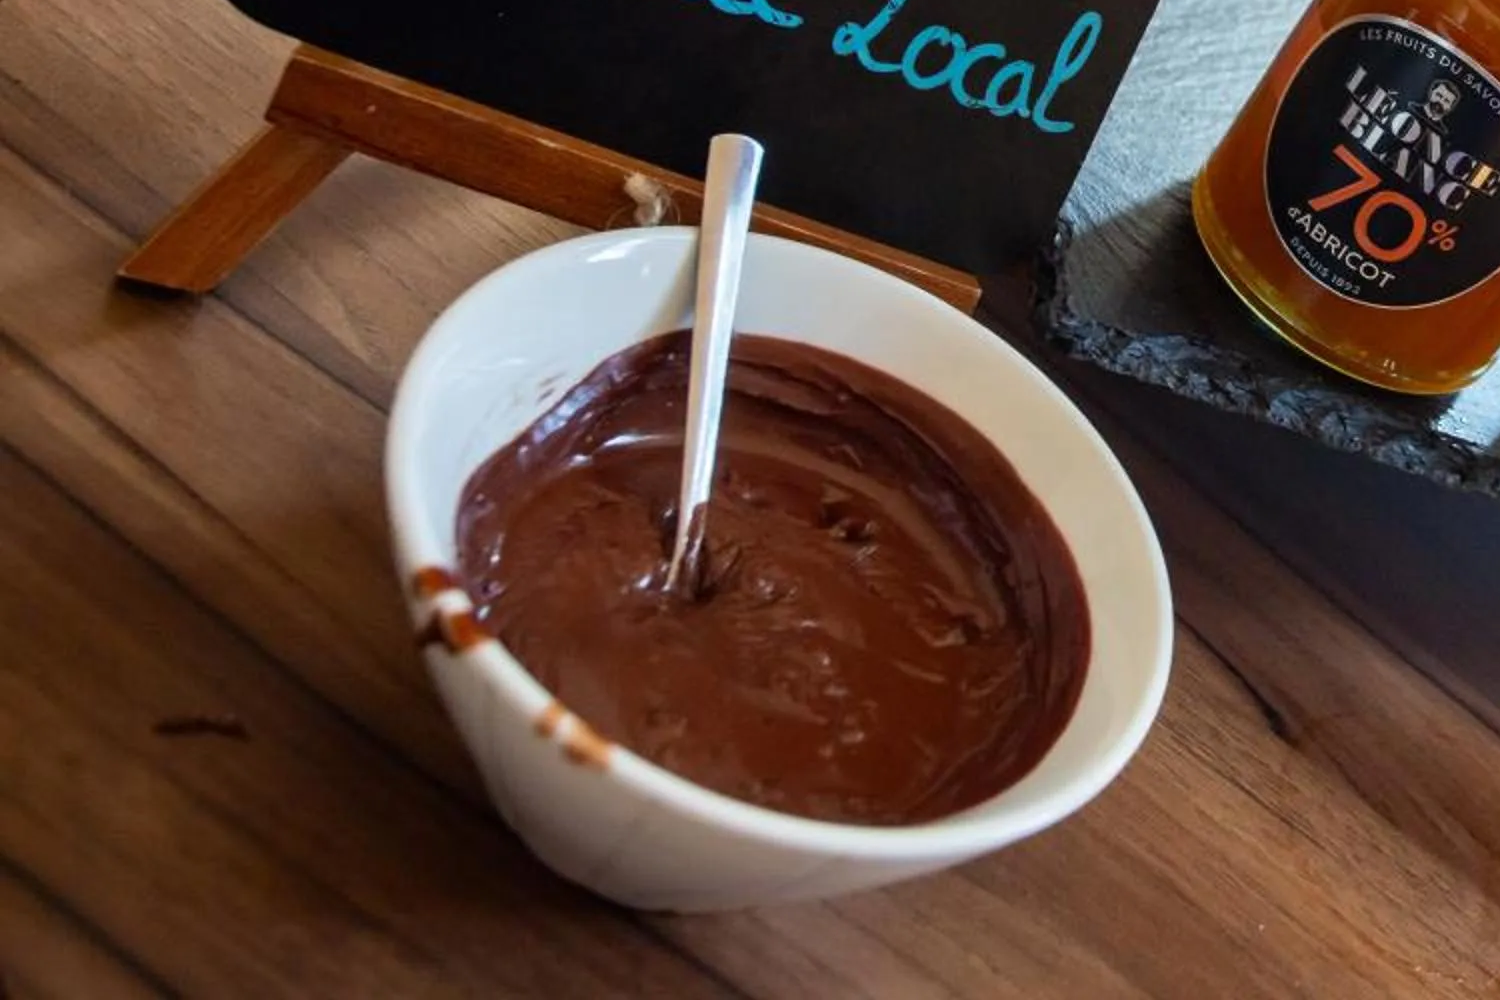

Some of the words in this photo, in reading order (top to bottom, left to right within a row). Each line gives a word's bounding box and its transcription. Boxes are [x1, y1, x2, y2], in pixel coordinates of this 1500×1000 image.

[1359, 27, 1384, 42] LES
[1384, 29, 1438, 60] FRUITS
[1438, 54, 1463, 77] DU
[1339, 99, 1472, 212] BLANC
[1289, 236, 1330, 279] DEPUIS
